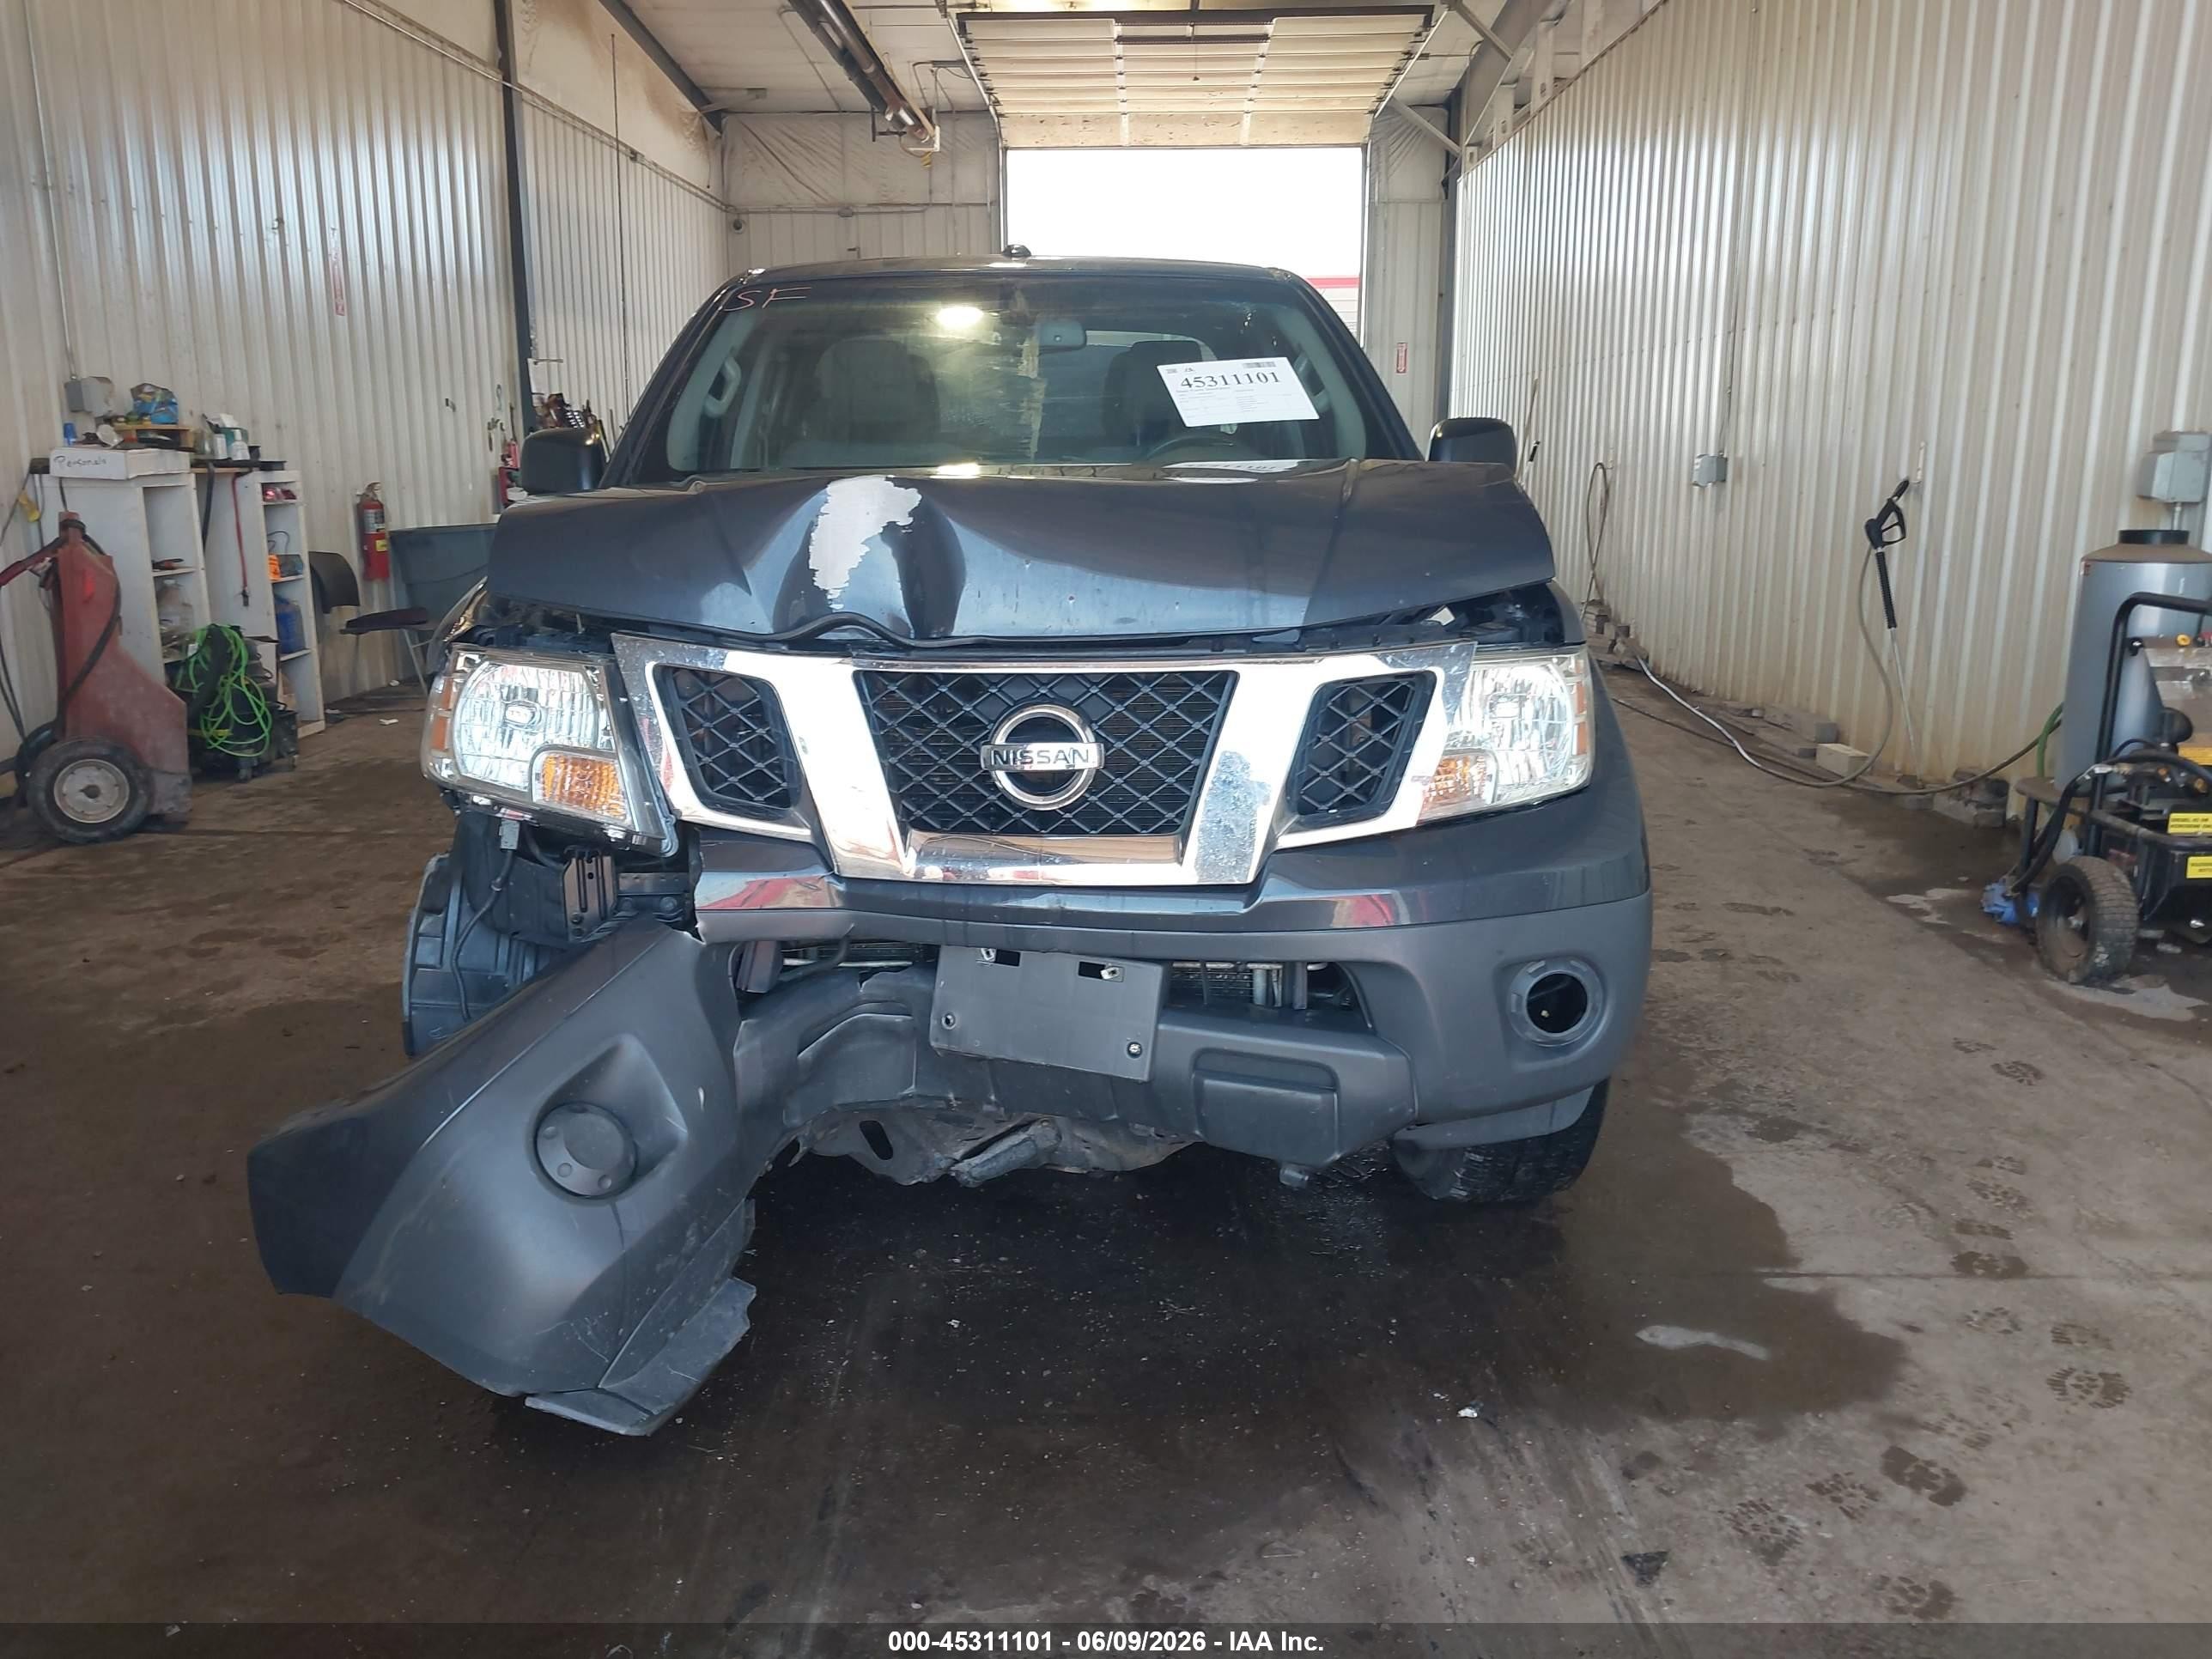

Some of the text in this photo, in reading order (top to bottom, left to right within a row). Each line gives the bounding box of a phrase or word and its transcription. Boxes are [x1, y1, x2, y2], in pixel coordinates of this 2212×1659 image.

[724, 287, 811, 311] SF
[1181, 372, 1279, 388] 45311101
[990, 748, 1089, 766] NISSAN
